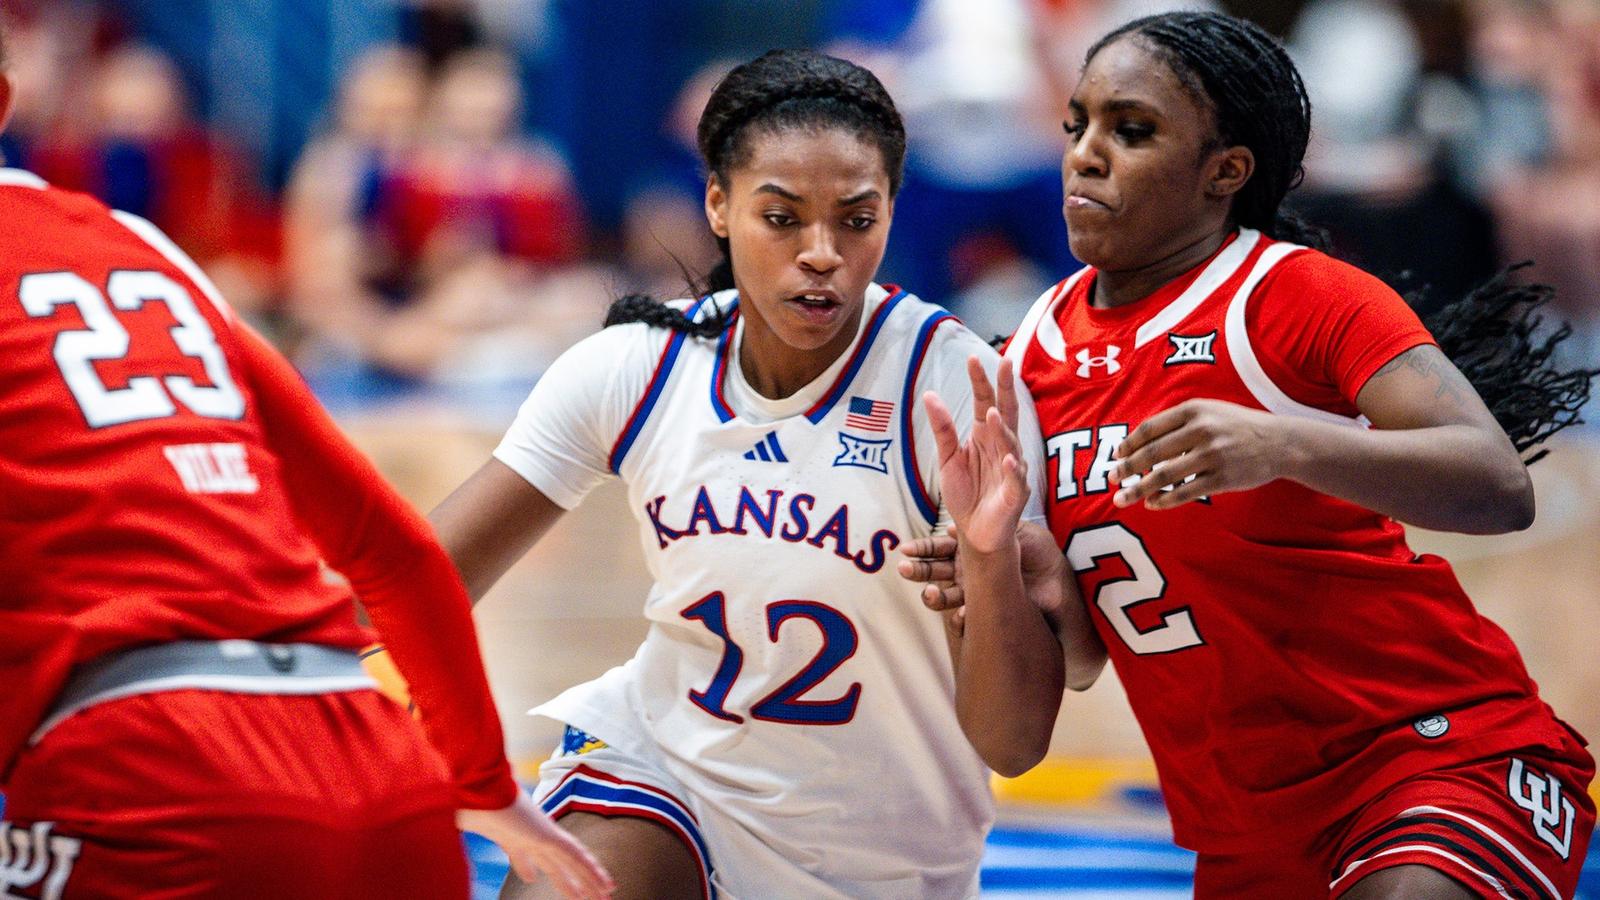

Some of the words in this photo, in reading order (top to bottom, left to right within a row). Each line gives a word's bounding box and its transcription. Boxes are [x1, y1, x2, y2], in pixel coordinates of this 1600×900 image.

[18, 268, 246, 431] 23
[646, 485, 900, 574] KANSAS
[1064, 520, 1206, 656] 2
[680, 590, 862, 725] 12
